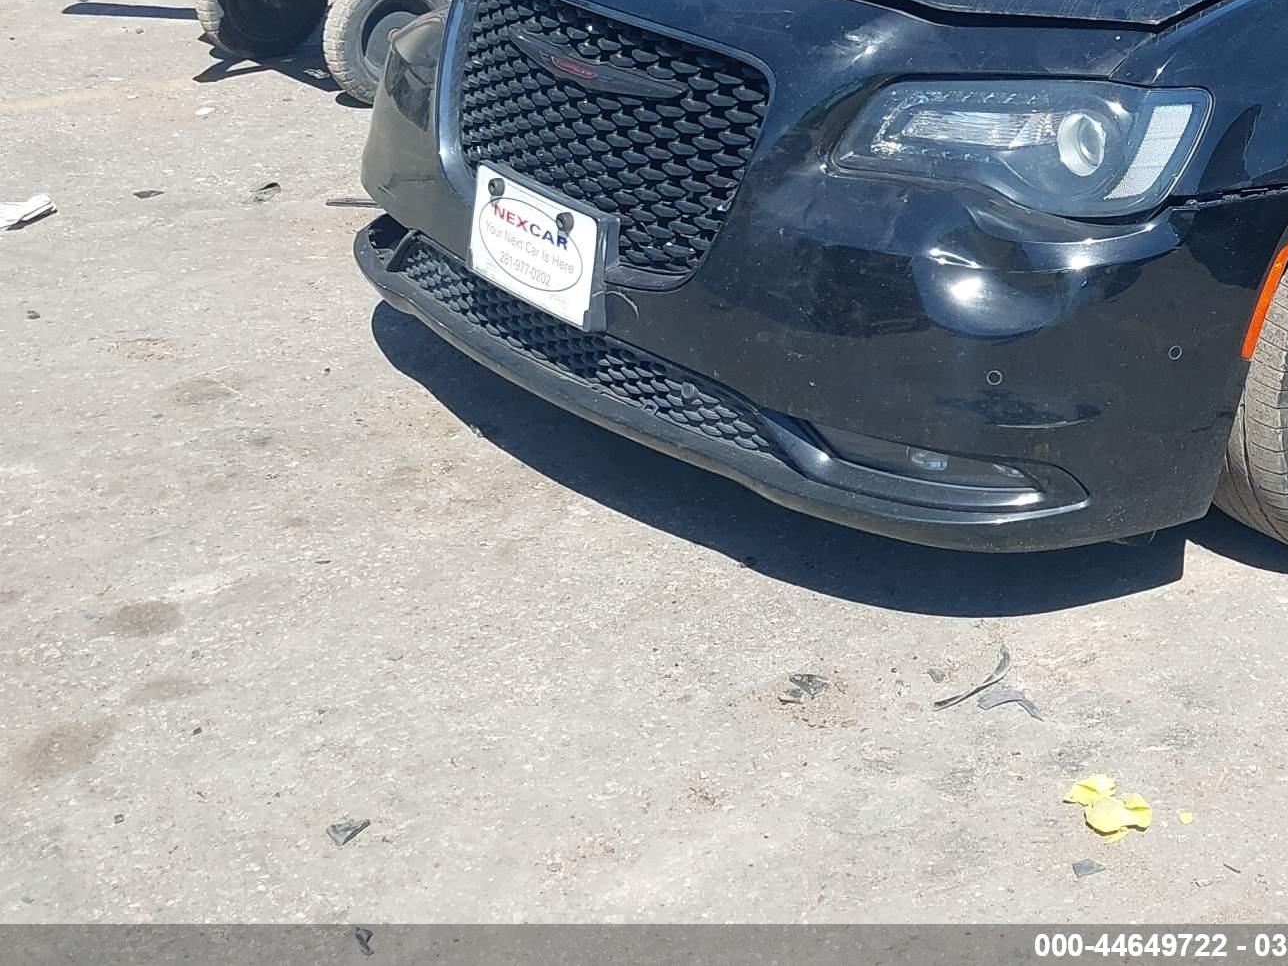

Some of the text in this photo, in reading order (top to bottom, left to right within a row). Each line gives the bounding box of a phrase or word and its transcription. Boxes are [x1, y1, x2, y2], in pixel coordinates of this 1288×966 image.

[486, 220, 574, 275] Your Next Car Is Here
[493, 203, 568, 250] NEXCAR
[499, 251, 552, 287] 281-977-0202
